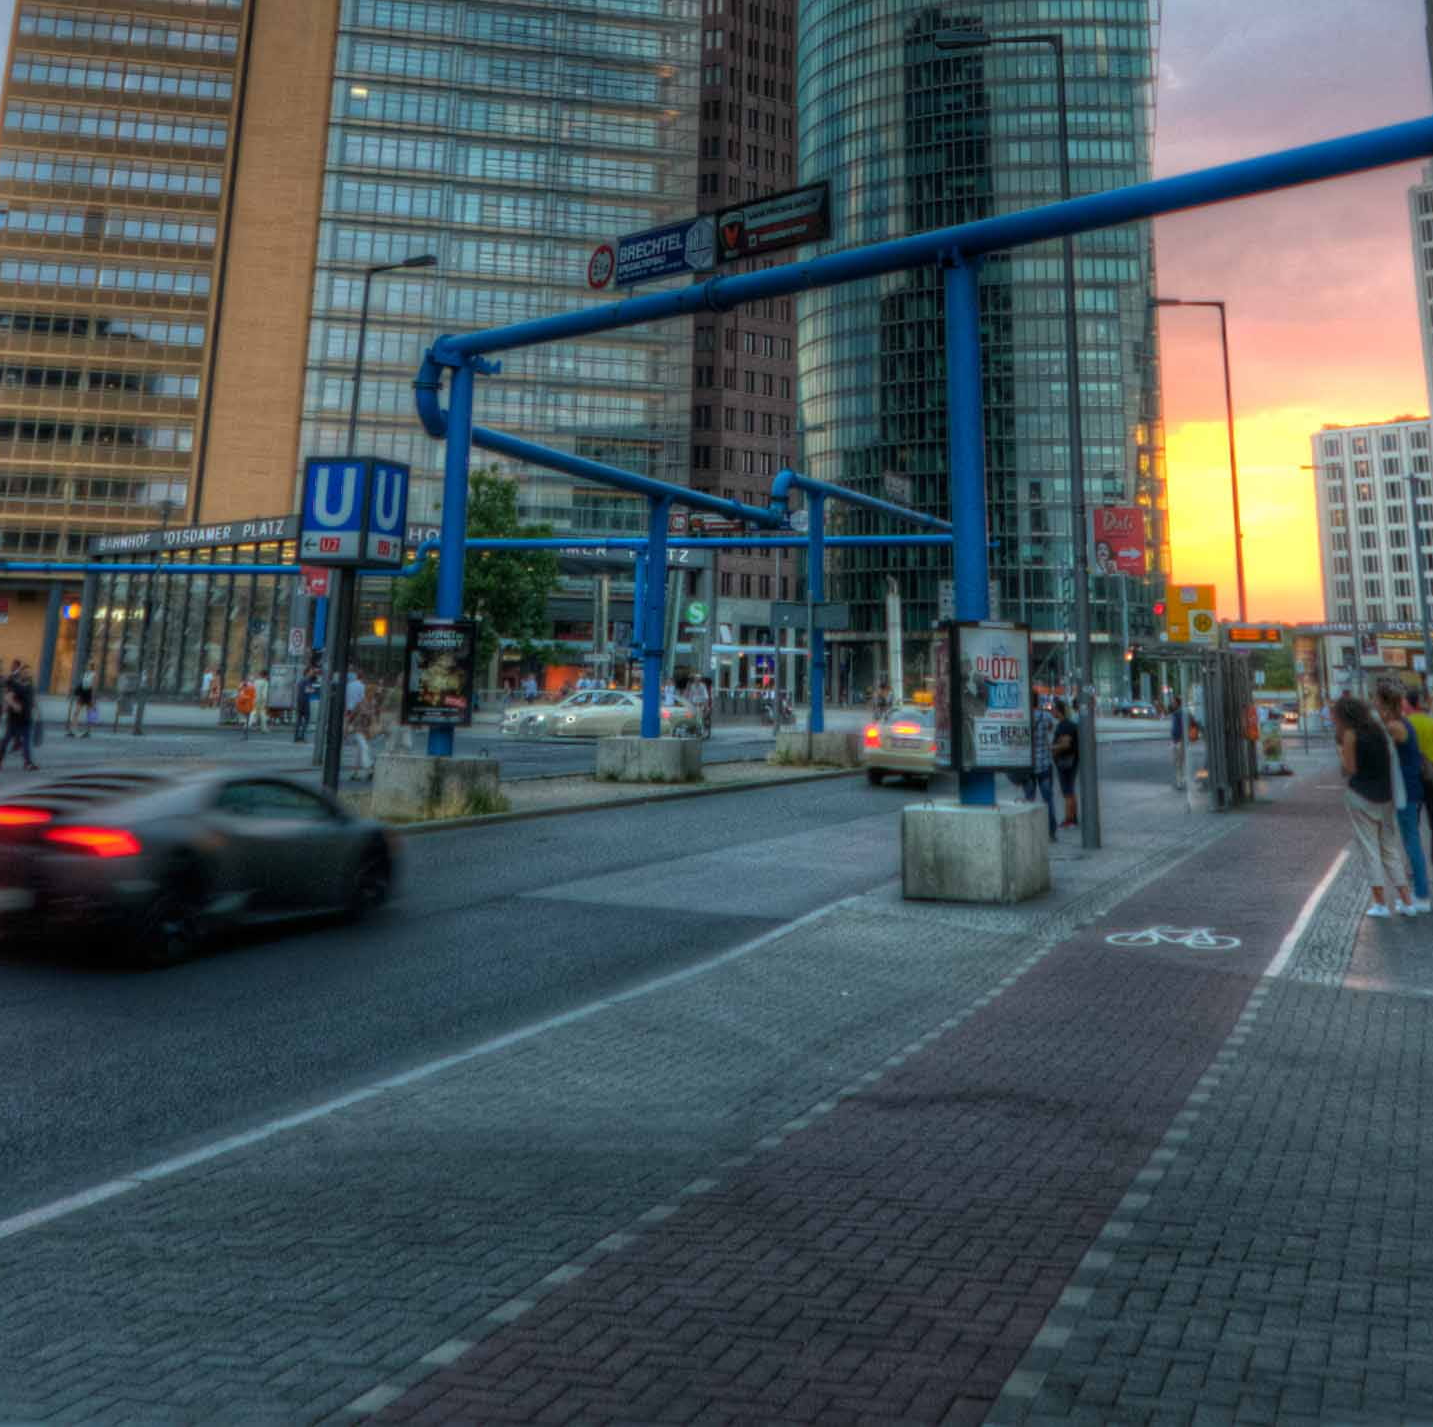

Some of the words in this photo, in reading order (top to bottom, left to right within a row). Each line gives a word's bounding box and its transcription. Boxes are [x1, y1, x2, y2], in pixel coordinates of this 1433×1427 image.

[619, 233, 683, 263] BRECHTEL
[313, 467, 358, 528] U
[375, 469, 402, 531] U
[99, 533, 151, 551] BAHNHOF
[242, 518, 285, 538] PLATZ
